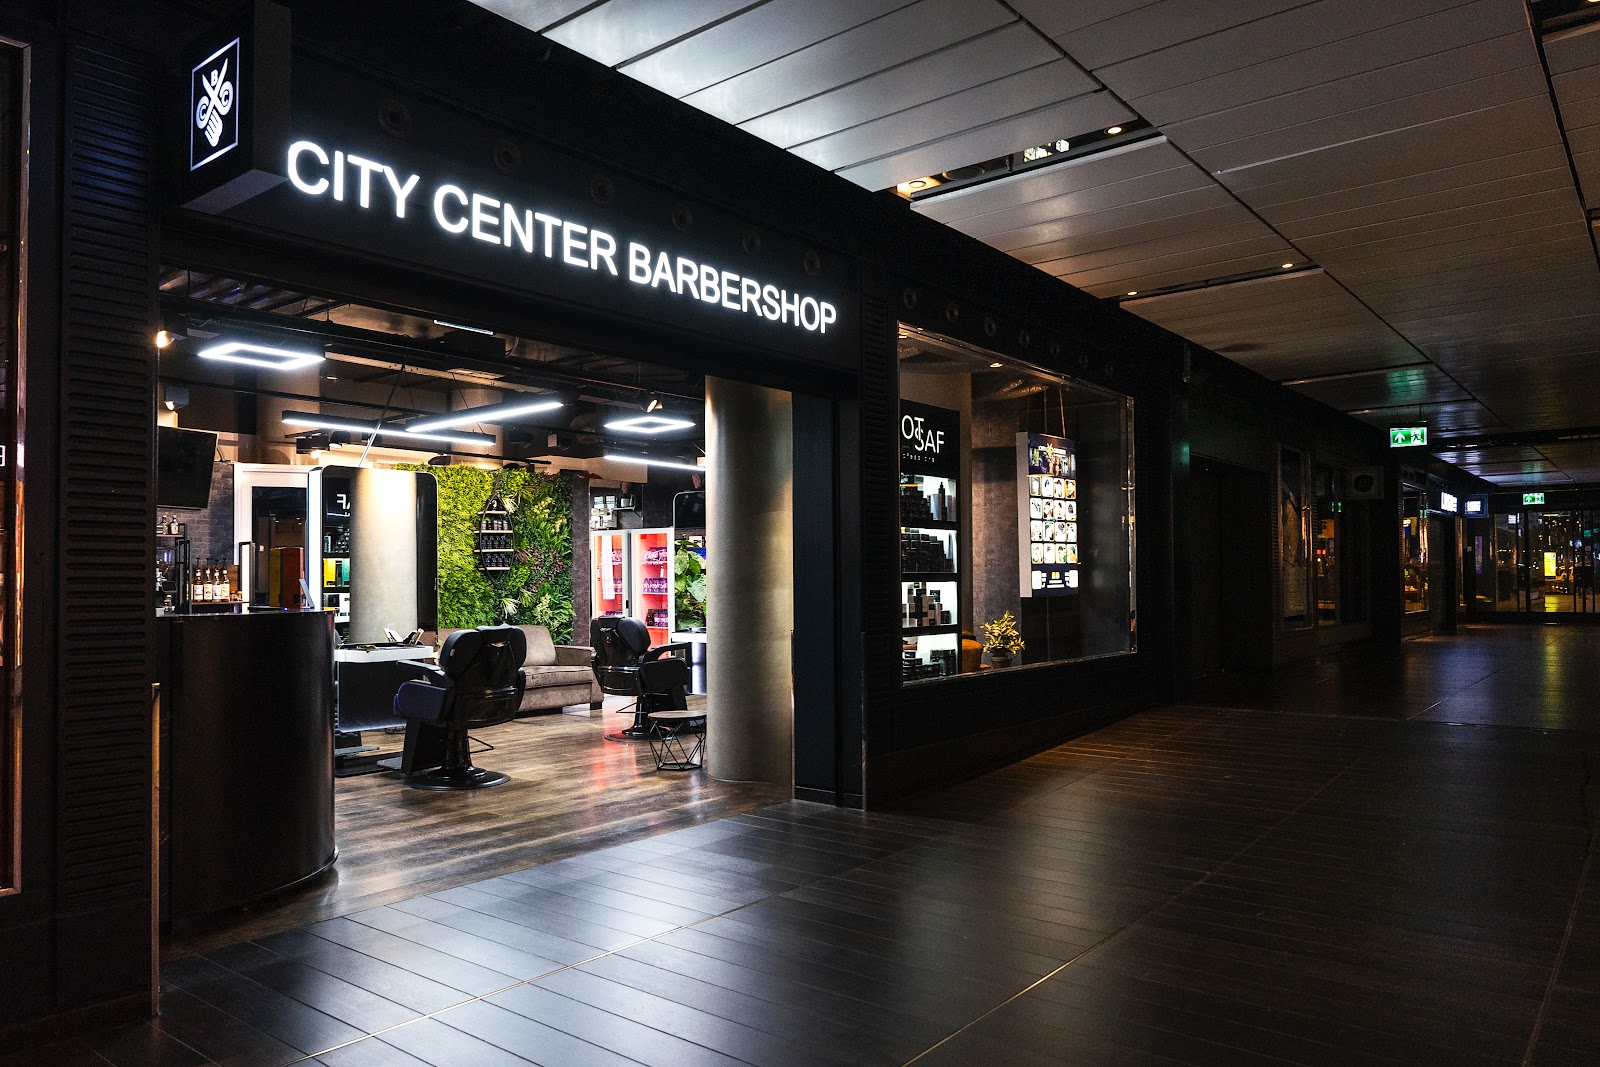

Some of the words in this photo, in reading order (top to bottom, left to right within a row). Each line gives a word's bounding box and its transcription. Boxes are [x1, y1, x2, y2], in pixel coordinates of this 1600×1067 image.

[287, 140, 421, 219] CITY
[433, 183, 619, 276] CENTER
[628, 241, 837, 334] BARBERSHOP
